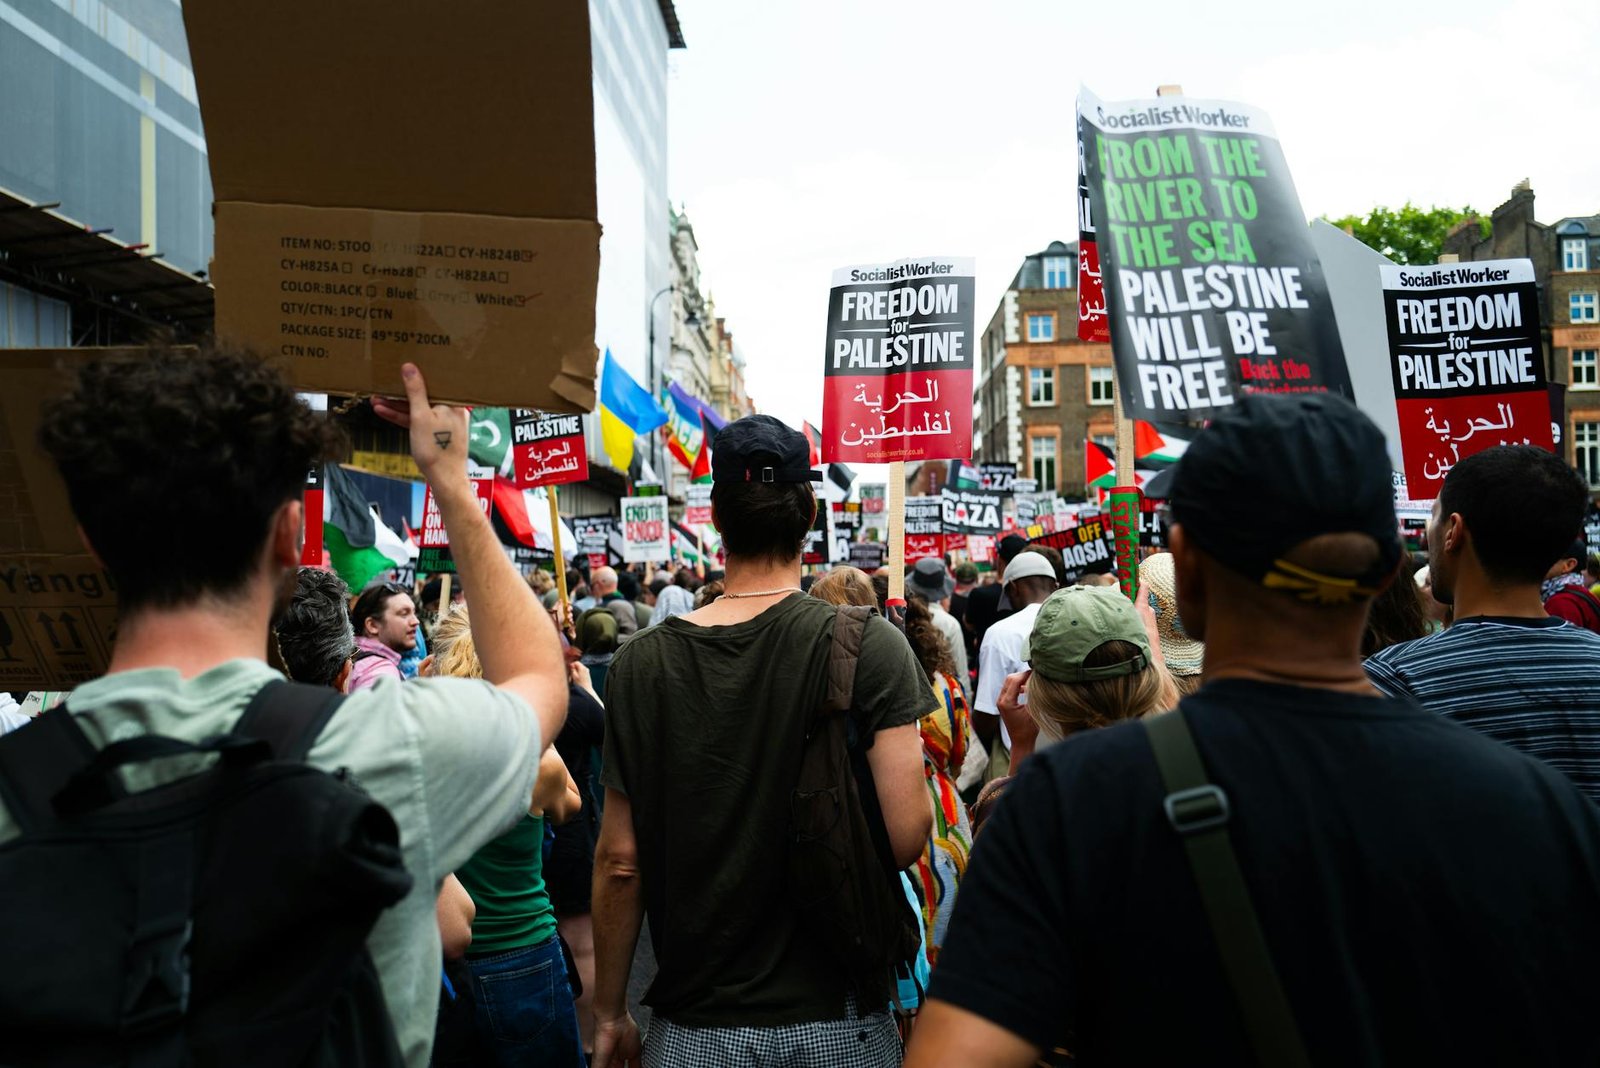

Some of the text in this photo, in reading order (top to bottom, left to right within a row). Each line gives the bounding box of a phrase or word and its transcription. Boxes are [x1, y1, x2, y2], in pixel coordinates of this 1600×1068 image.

[1096, 134, 1194, 178] FROM
[1199, 137, 1267, 177] THE
[1102, 178, 1207, 222] RIVER
[1210, 178, 1258, 221] TO
[281, 237, 311, 249] ITEM
[314, 239, 336, 251] NO:
[458, 247, 520, 261] CY-H824B
[1109, 223, 1181, 268] THE
[1187, 221, 1257, 263] SEA
[281, 258, 339, 273] CY-H825A
[386, 287, 413, 299] Blue
[476, 292, 513, 306] White
[841, 284, 958, 321] FREEDOM
[1118, 265, 1309, 314] PALESTINE
[281, 302, 393, 320] QTY/CTN: 1PC/CTN
[1396, 292, 1522, 334] FREEDOM
[281, 323, 334, 337] PACKAGE
[337, 327, 365, 339] SIZE:
[890, 319, 909, 334] for
[1126, 311, 1277, 361] WILL BE
[281, 344, 329, 358] CTN NO:
[833, 331, 964, 369] PALESTINE
[1448, 332, 1470, 350] for
[1240, 359, 1310, 379] Back the
[1398, 347, 1536, 390] PALESTINE
[853, 378, 939, 414] الحرية
[1137, 360, 1234, 410] FREE
[515, 416, 580, 442] PALESTINE
[841, 410, 951, 447] لفلسطين
[1424, 403, 1514, 442] الحرية
[528, 441, 571, 462] الحرية
[525, 457, 579, 481] لفلسطين
[961, 492, 999, 506] Starving
[942, 500, 1000, 528] GAZA
[1078, 522, 1101, 543] OFF
[1062, 537, 1109, 570] AQSA
